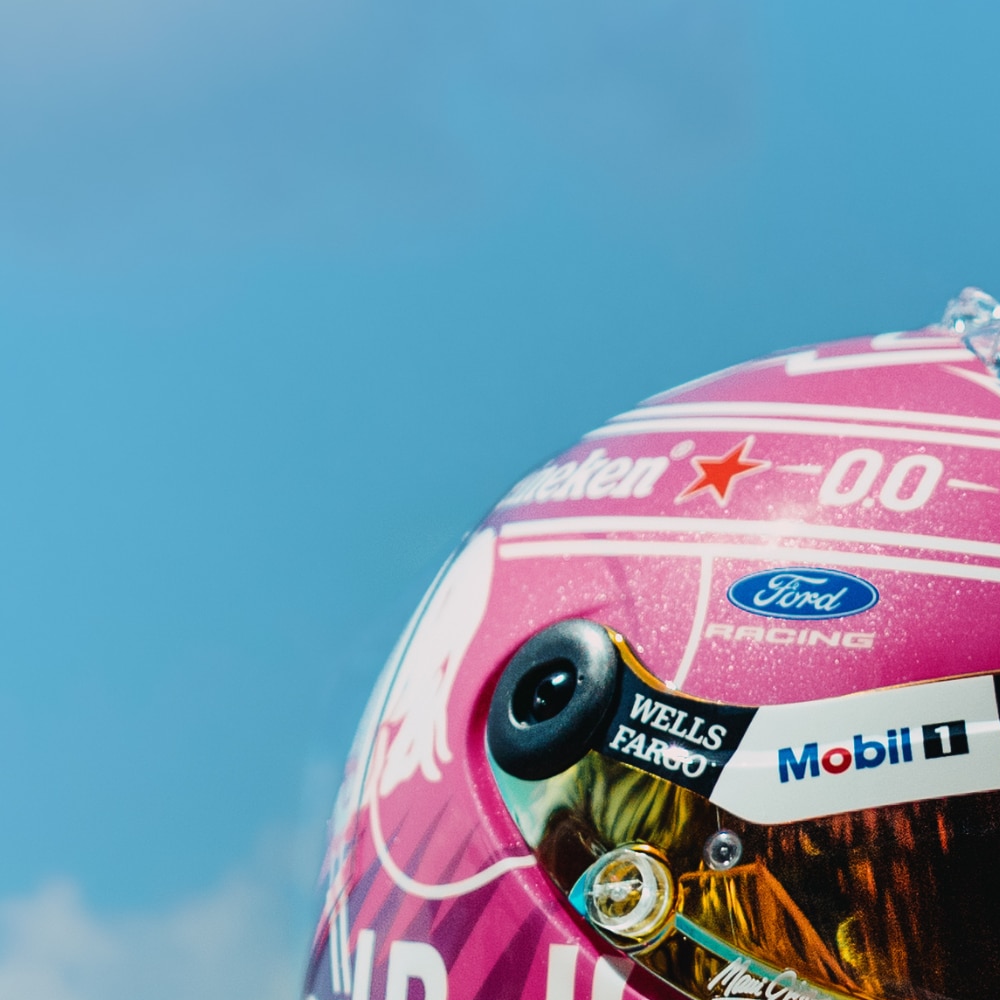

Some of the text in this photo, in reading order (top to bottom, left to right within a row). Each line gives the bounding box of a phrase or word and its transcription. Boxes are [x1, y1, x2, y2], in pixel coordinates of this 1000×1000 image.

[753, 573, 848, 612] Ford
[705, 623, 876, 648] RACING
[629, 693, 728, 750] WELLS
[608, 724, 708, 778] FARGO
[778, 727, 913, 783] Mobil
